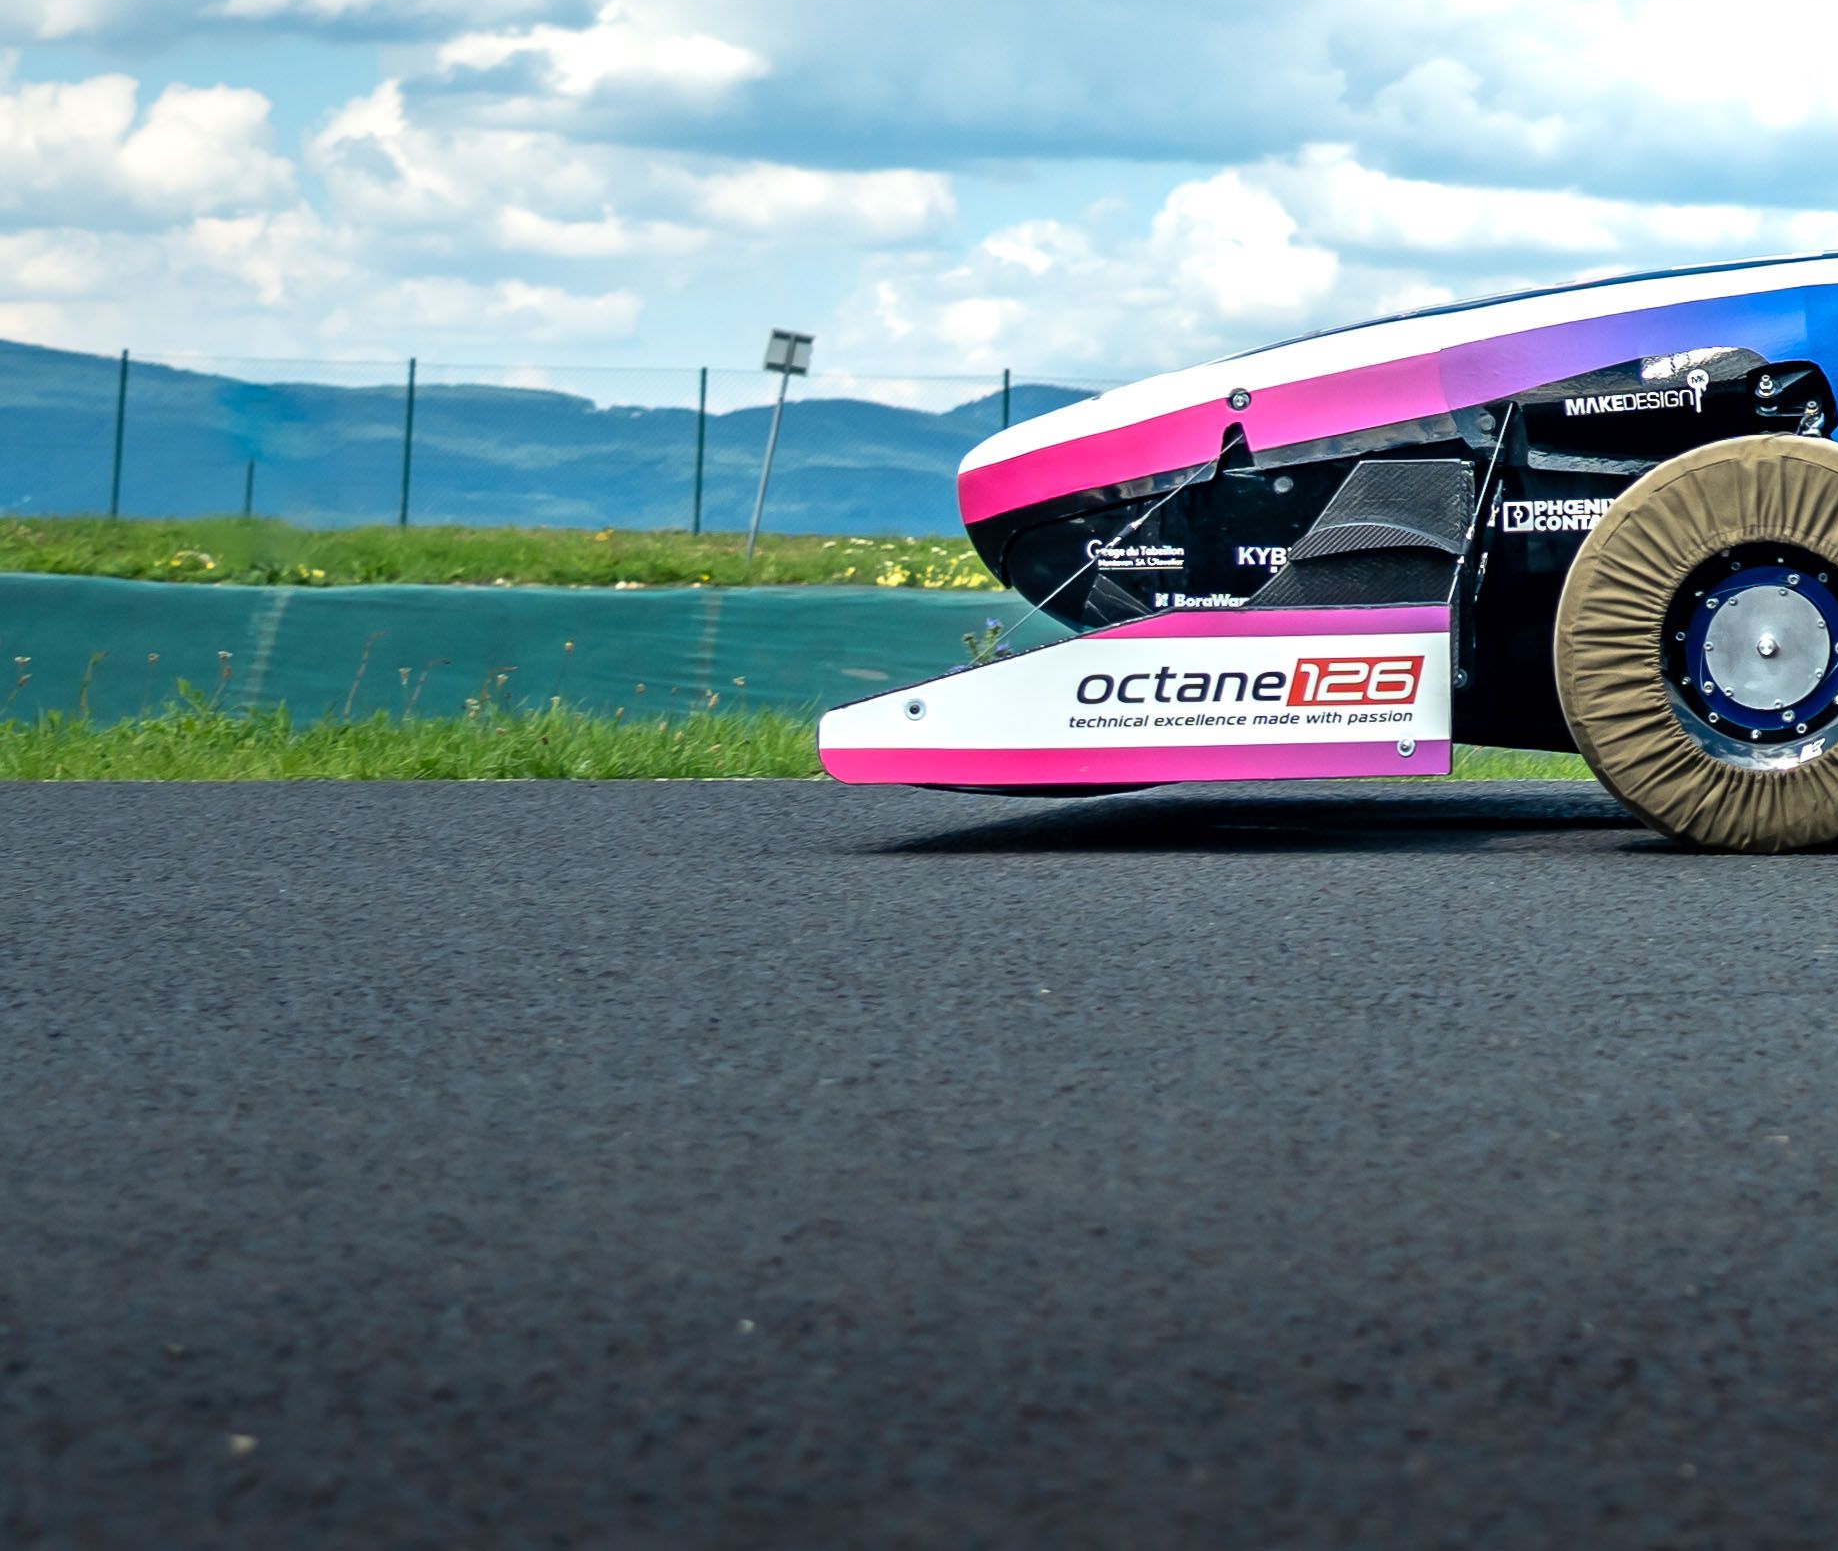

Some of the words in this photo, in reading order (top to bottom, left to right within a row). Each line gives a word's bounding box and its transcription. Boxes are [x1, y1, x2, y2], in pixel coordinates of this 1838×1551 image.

[1237, 546, 1287, 565] KYB
[1069, 715, 1149, 729] technical
[1154, 713, 1247, 727] excellence
[1253, 712, 1300, 725] made
[1306, 711, 1342, 724] with
[1347, 710, 1413, 726] passion
